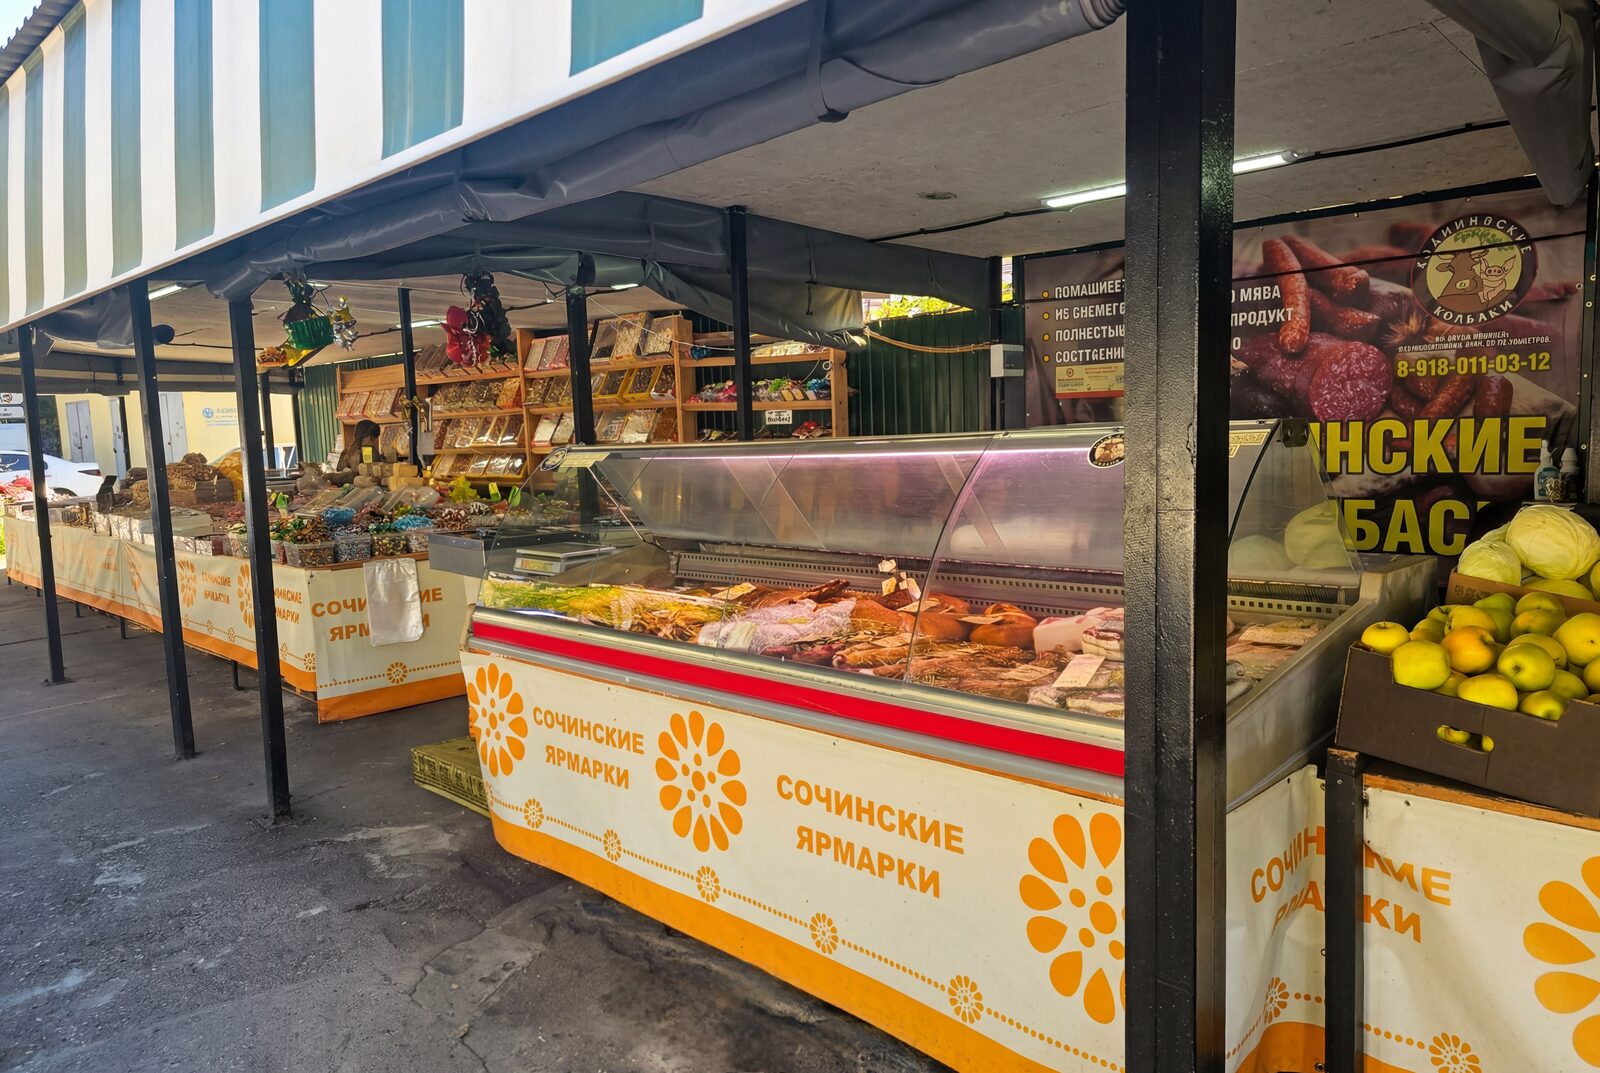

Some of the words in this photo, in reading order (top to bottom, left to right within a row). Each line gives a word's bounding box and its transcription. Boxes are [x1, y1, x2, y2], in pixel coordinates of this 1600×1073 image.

[1231, 307, 1294, 327] ПРОДУКТ
[1397, 351, 1551, 378] 8-918-011-03-12
[1340, 498, 1490, 556] БАС
[311, 587, 443, 618] СОЧИИЕ
[533, 706, 645, 755] СОЧИНСКИЕ
[545, 744, 629, 790] ЯРМАРКИ
[776, 774, 965, 855] СОЧИНСКИЕ
[796, 825, 940, 898] ЯРМАРКИ
